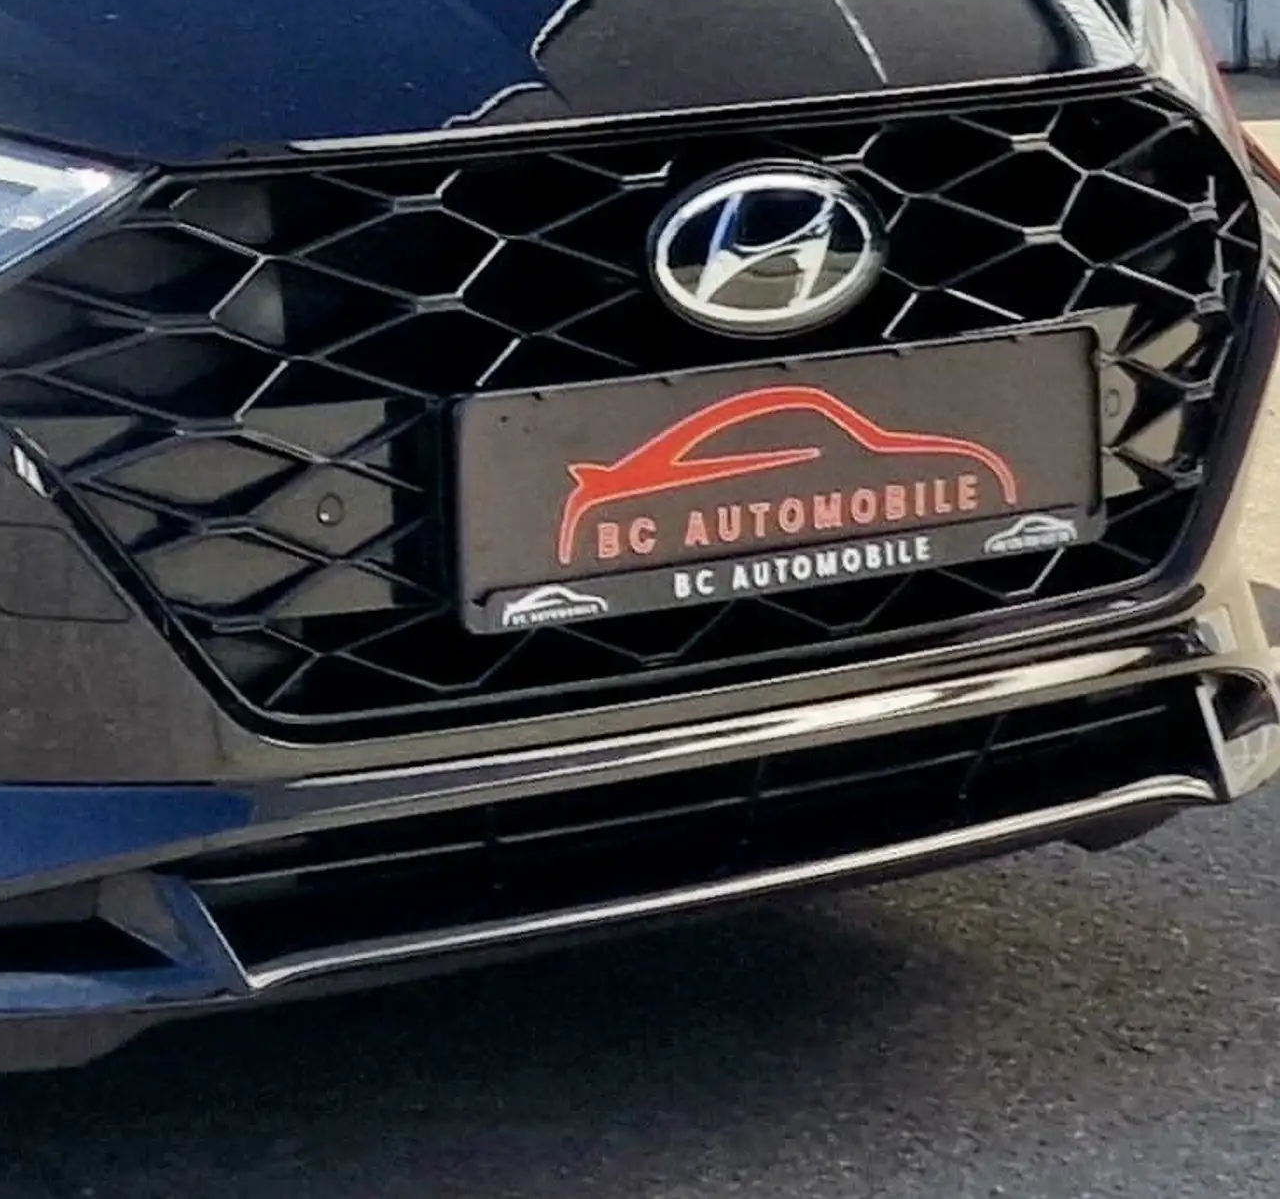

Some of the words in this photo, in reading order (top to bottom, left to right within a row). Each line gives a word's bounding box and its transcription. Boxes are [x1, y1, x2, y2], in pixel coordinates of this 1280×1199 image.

[597, 516, 656, 560] BC
[684, 473, 979, 546] AUTOMOBILE
[674, 568, 715, 599] BC
[732, 537, 932, 590] AUTOMOBILE
